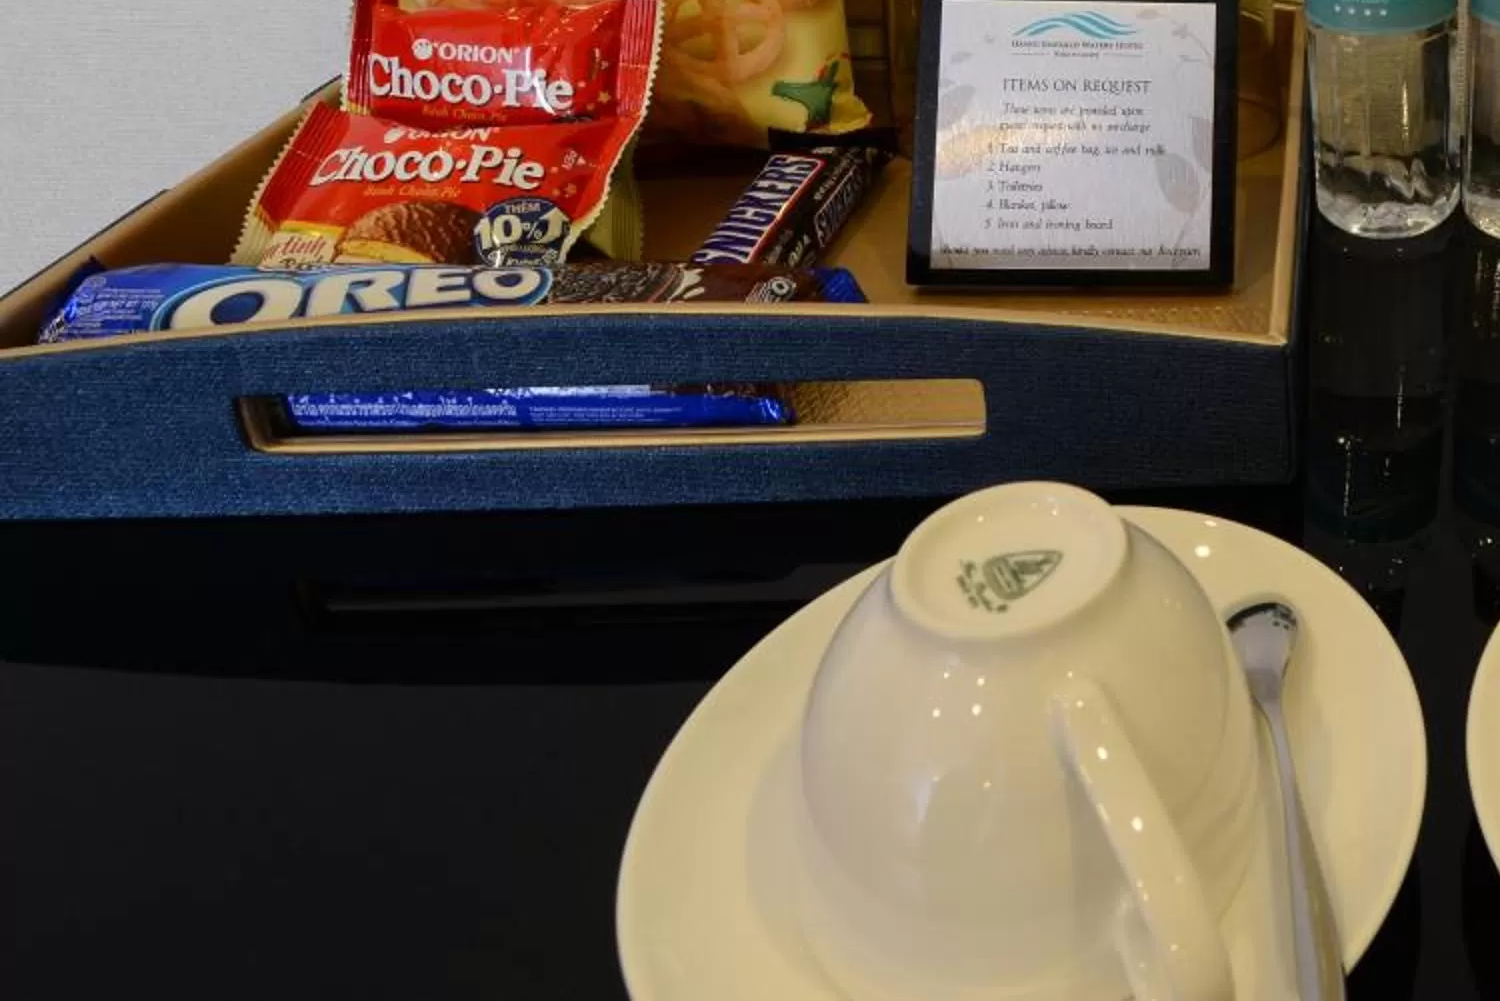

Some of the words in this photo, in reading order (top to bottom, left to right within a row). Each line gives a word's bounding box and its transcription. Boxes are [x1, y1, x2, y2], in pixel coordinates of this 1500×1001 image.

[437, 42, 515, 66] ORION
[1003, 77, 1049, 92] ITEMS
[1053, 78, 1077, 92] ON
[1082, 78, 1153, 96] REQUEST
[1000, 142, 1019, 154] Tea
[1021, 142, 1041, 154] and
[998, 160, 1041, 175] Hangers
[997, 180, 1043, 193] Toiletries
[692, 154, 822, 264] SNICKERS
[474, 214, 543, 250] 10%
[1022, 217, 1042, 231] and
[1085, 217, 1114, 231] board
[169, 267, 542, 330] OREO
